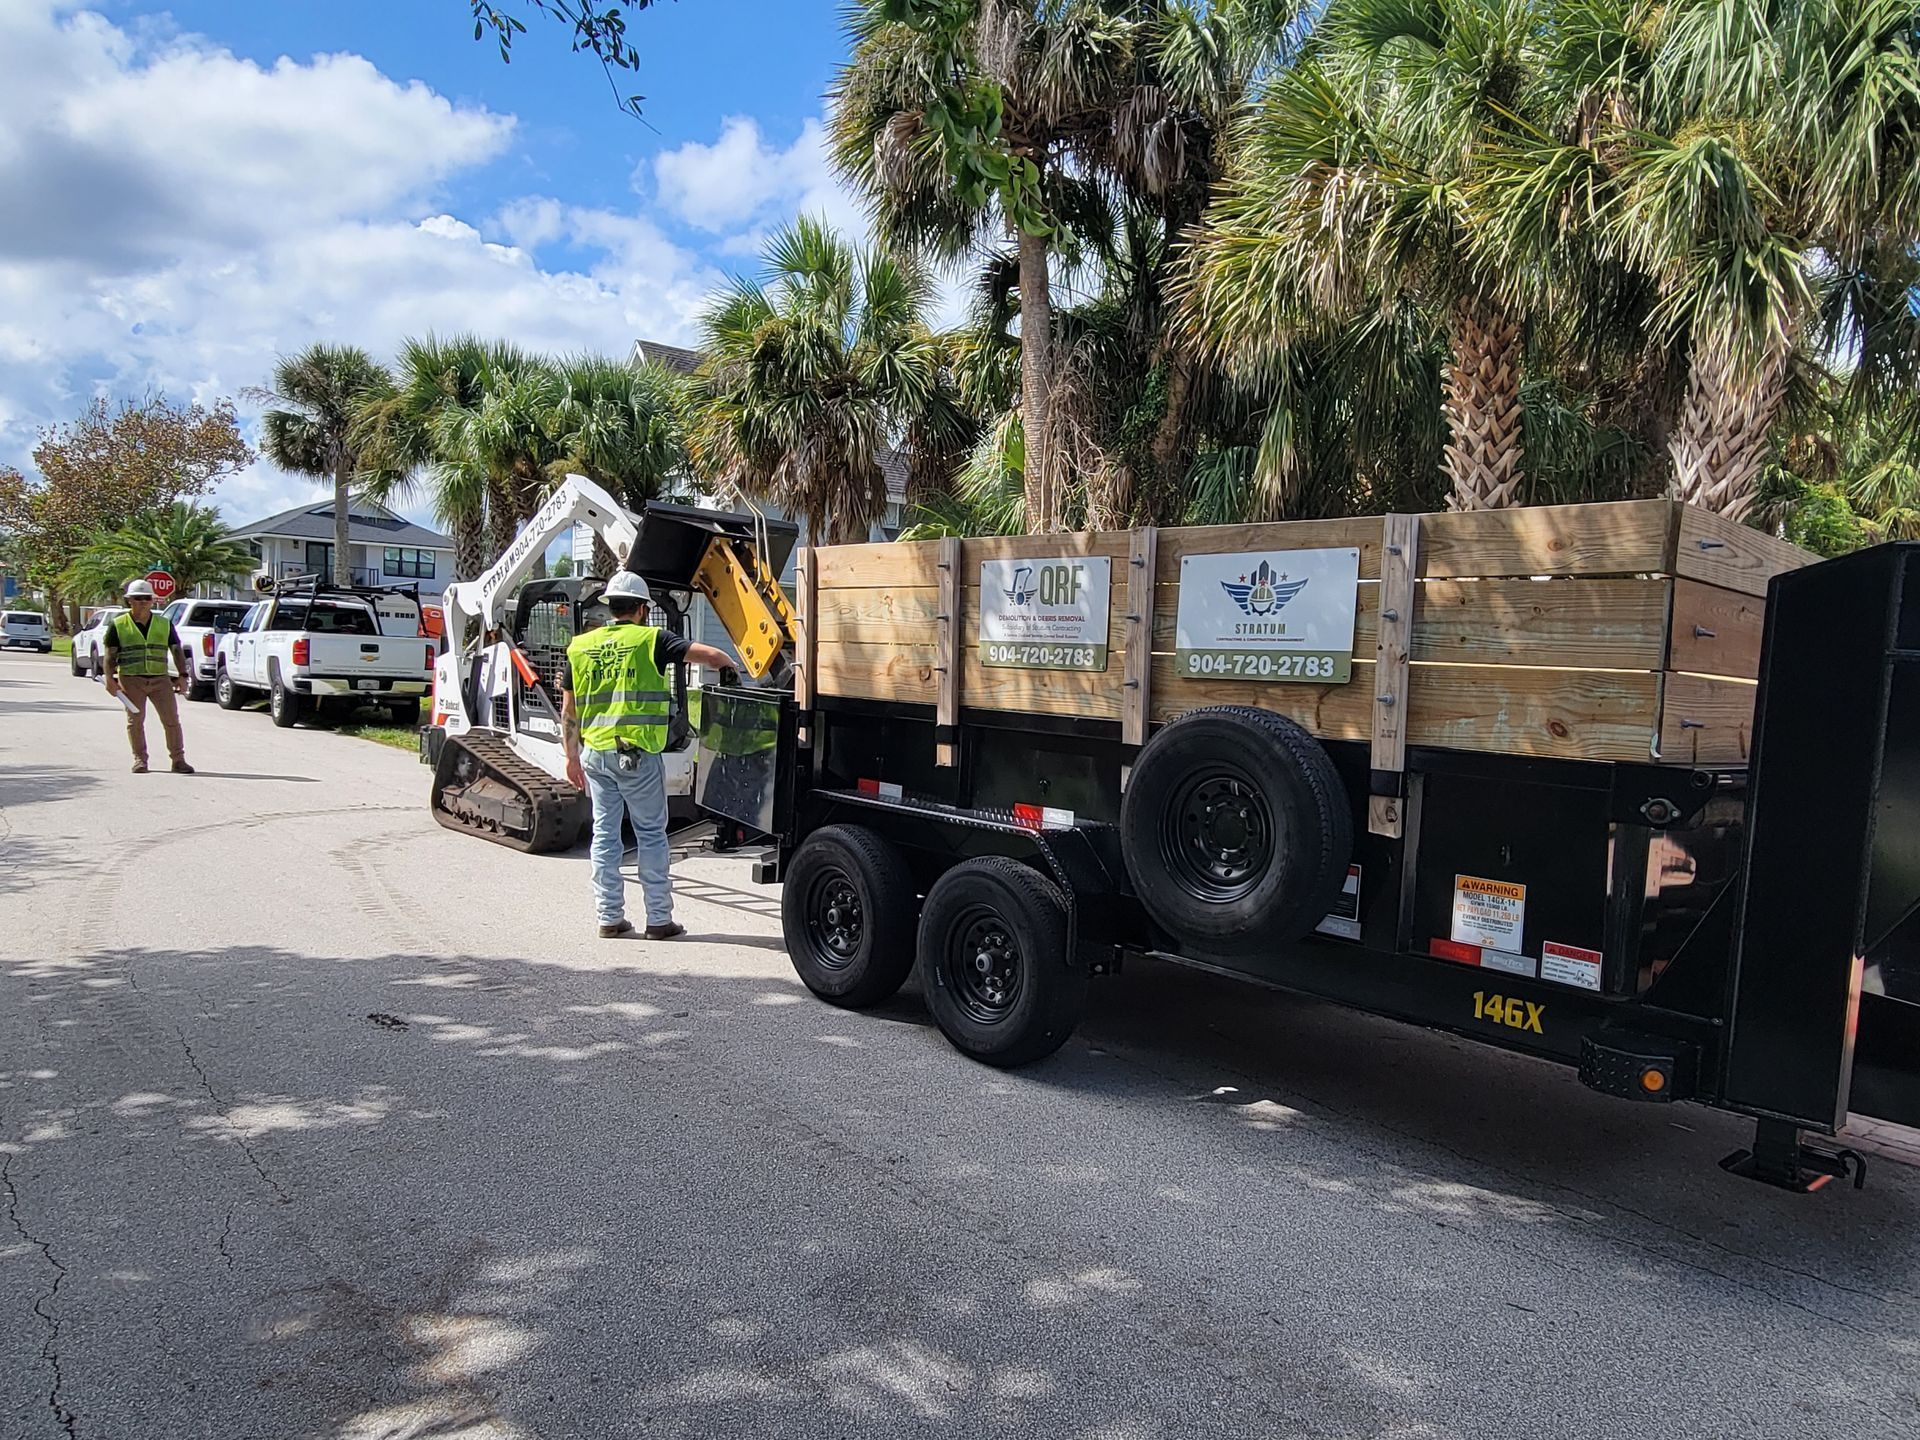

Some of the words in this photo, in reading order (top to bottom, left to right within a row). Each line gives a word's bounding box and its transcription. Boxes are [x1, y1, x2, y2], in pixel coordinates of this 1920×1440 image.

[514, 490, 567, 561] 904-720-2783
[1039, 565, 1084, 607] QRF
[1052, 624, 1082, 633] Contracting
[1235, 623, 1286, 635] STRATUM
[989, 645, 1095, 666] 904-720-2783
[1188, 654, 1335, 678] 904-720-2783
[585, 668, 635, 681] STRATUM
[1470, 880, 1519, 897] WARNING
[1462, 891, 1484, 902] MODEL
[1488, 895, 1516, 907] 14GX-14
[1467, 904, 1492, 917] PAYLOAD
[1481, 917, 1514, 928] DISTRIBUTED
[1559, 948, 1594, 961] DANGER
[1473, 991, 1546, 1035] 14GX
